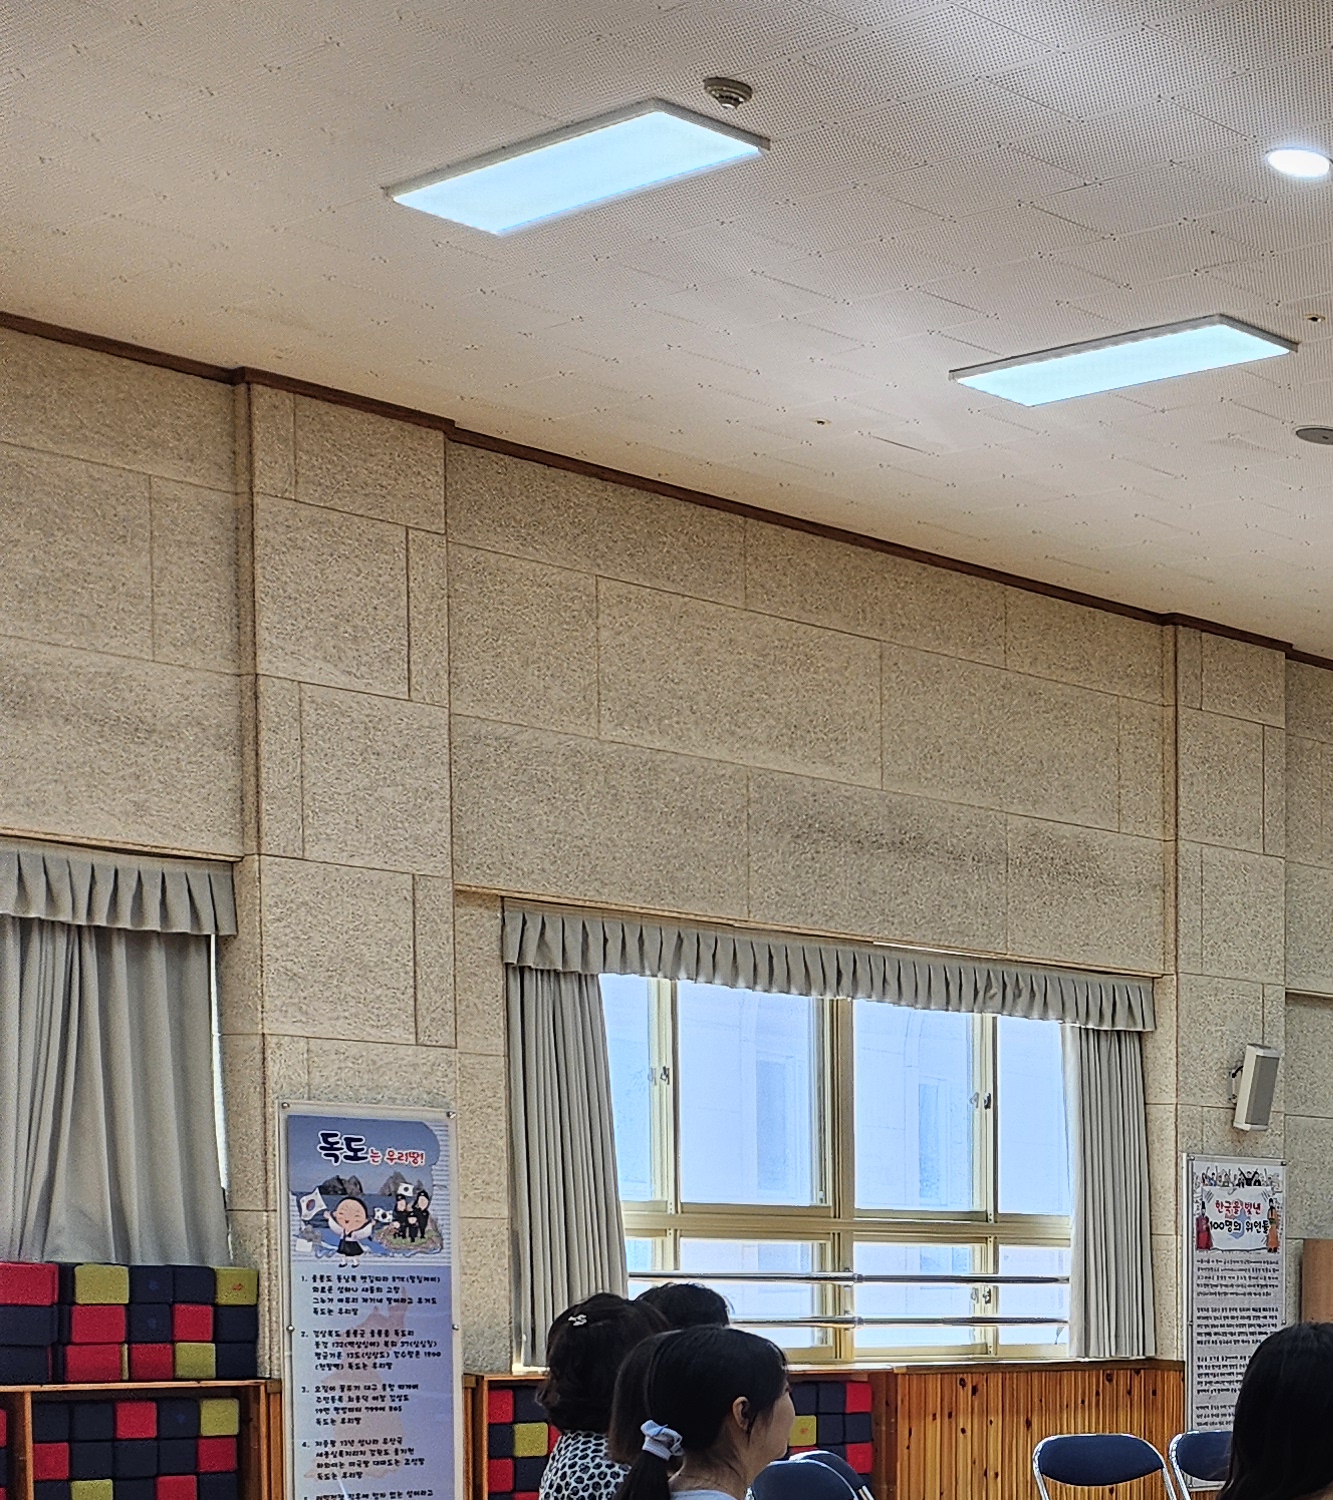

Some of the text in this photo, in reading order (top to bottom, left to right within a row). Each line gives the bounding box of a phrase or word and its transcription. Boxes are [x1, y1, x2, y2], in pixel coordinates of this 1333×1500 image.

[318, 1131, 425, 1165] 독도는 우리땅!
[1215, 1200, 1240, 1214] 한국을
[1210, 1220, 1269, 1234] 100명의 위인들
